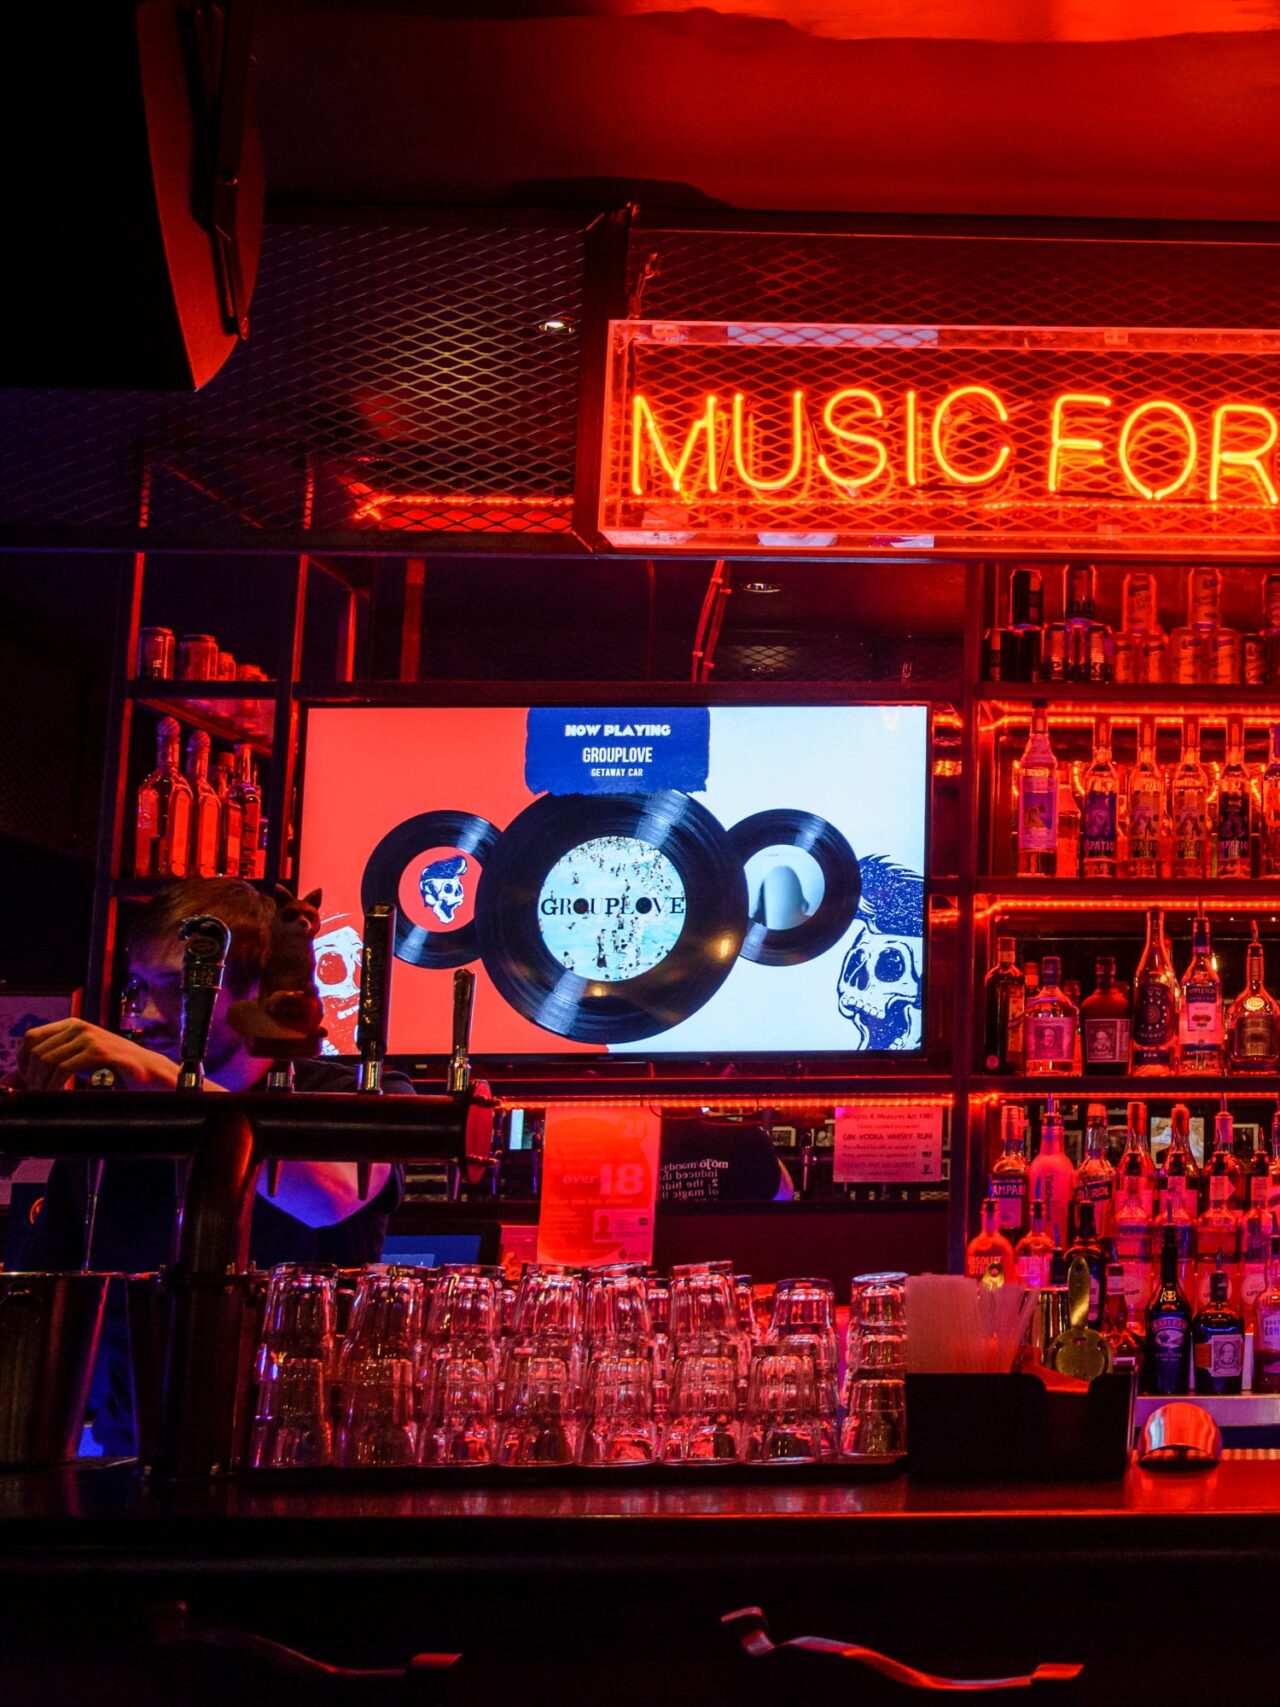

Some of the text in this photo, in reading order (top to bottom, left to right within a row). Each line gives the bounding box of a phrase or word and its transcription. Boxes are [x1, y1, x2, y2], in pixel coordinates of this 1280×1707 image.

[631, 386, 1010, 494] MUSIC
[1047, 394, 1279, 504] FOR
[564, 725, 672, 736] NOW PLAYING
[582, 747, 653, 763] GROUPLOVE
[590, 768, 643, 777] GETAWAY CAR
[541, 897, 685, 915] GROUPLOVE
[563, 1164, 645, 1195] over 18
[988, 1183, 1026, 1197] AMPARI
